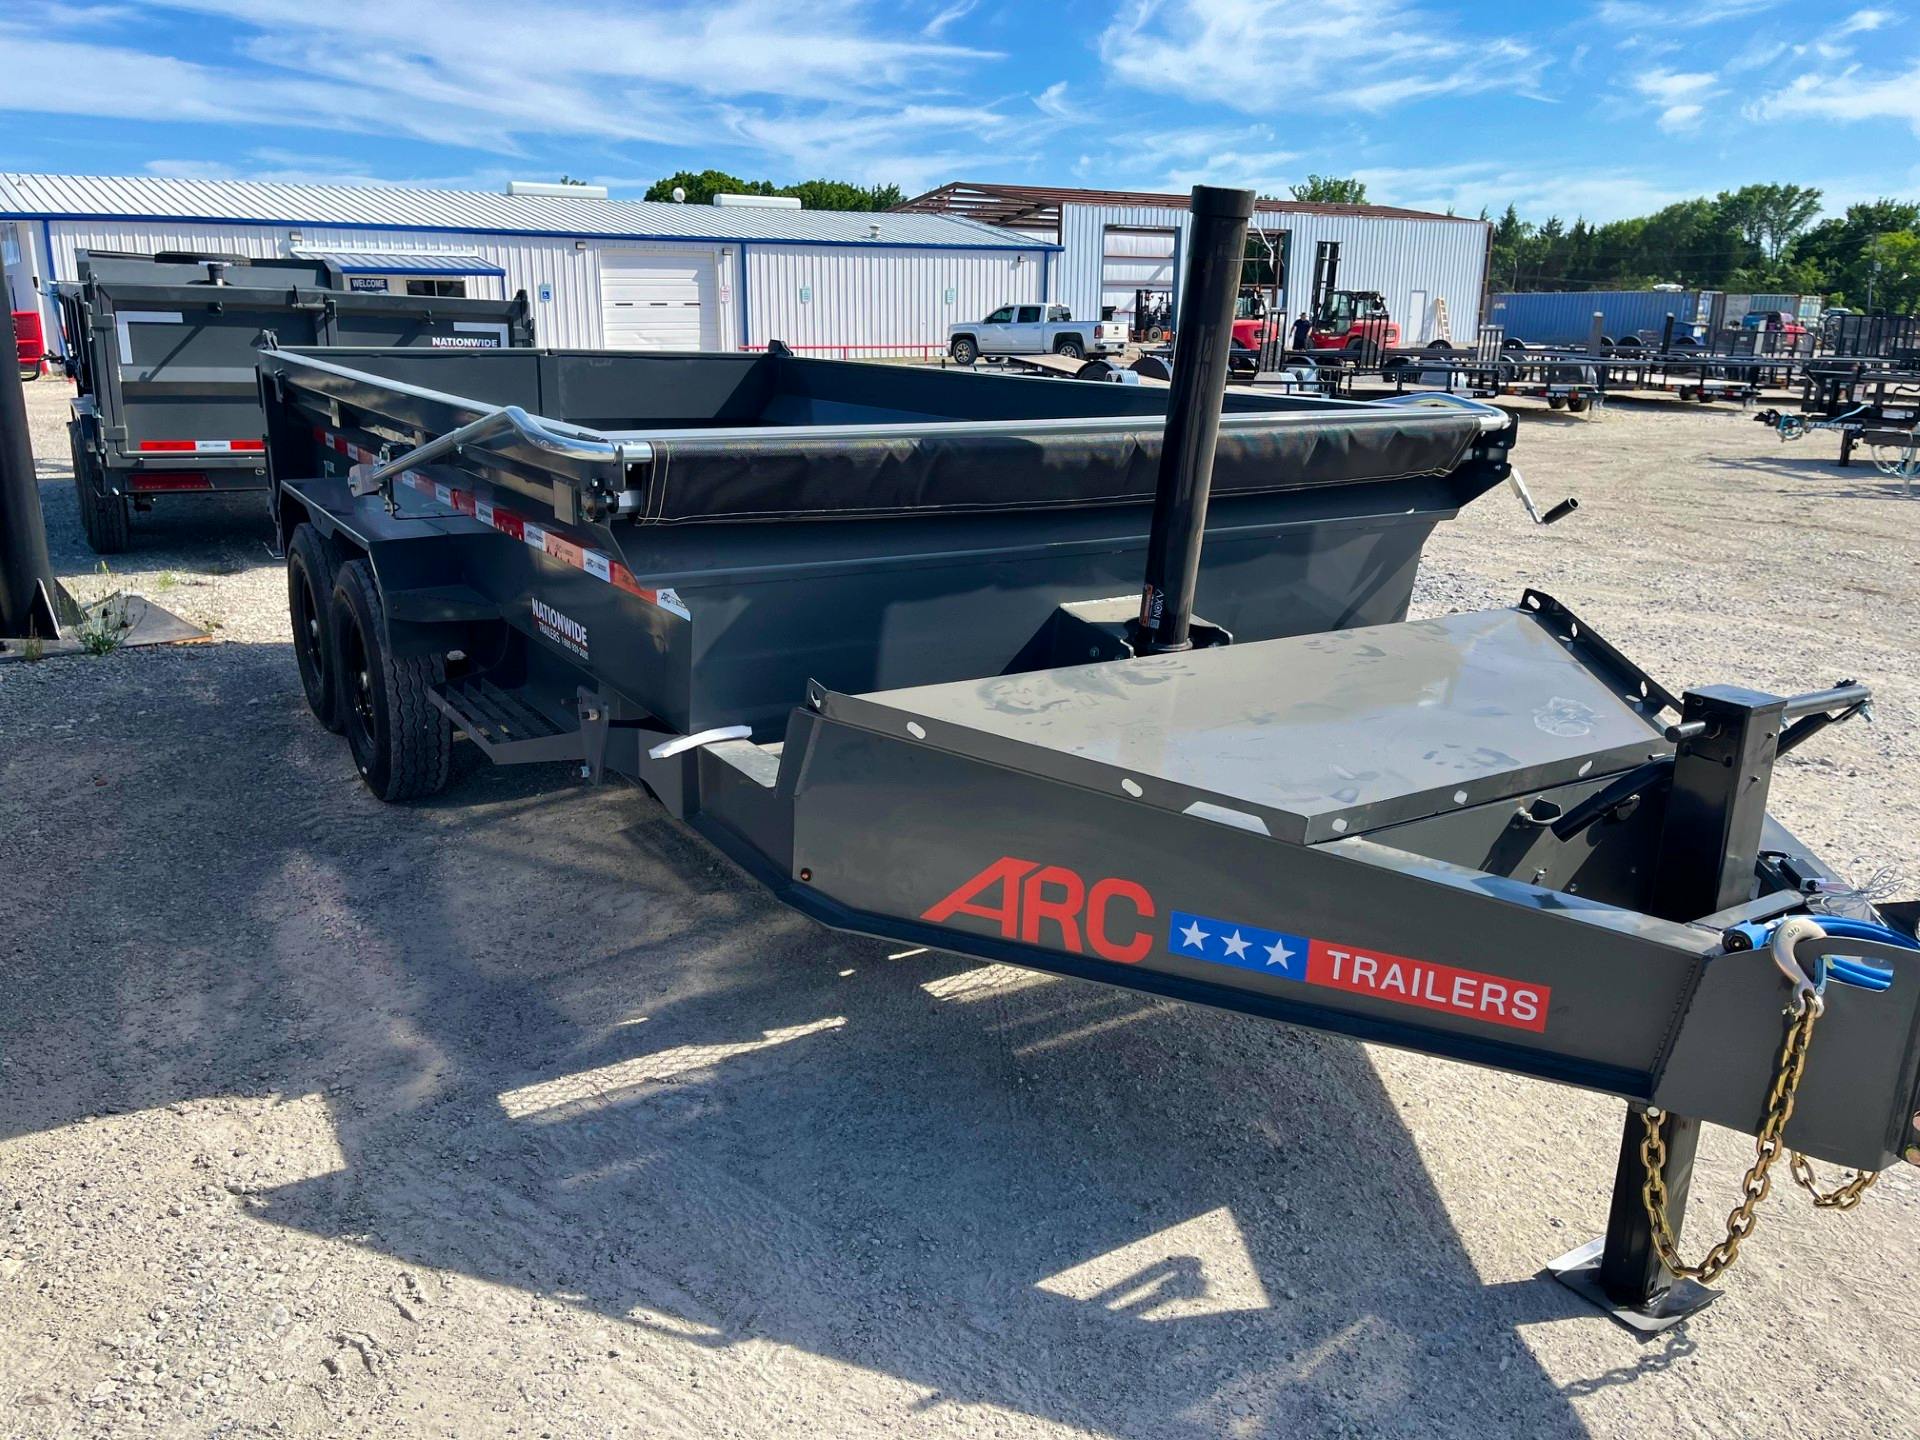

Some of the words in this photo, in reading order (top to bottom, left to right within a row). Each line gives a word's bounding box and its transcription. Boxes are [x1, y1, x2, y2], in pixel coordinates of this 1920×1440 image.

[352, 279, 386, 288] WELCOME
[431, 337, 498, 347] NATIONWIDE
[531, 597, 588, 646] NATIONWIDE
[538, 621, 560, 645] TRAILERS
[920, 856, 1155, 964] ARC
[1326, 949, 1539, 1022] TRAILERS
